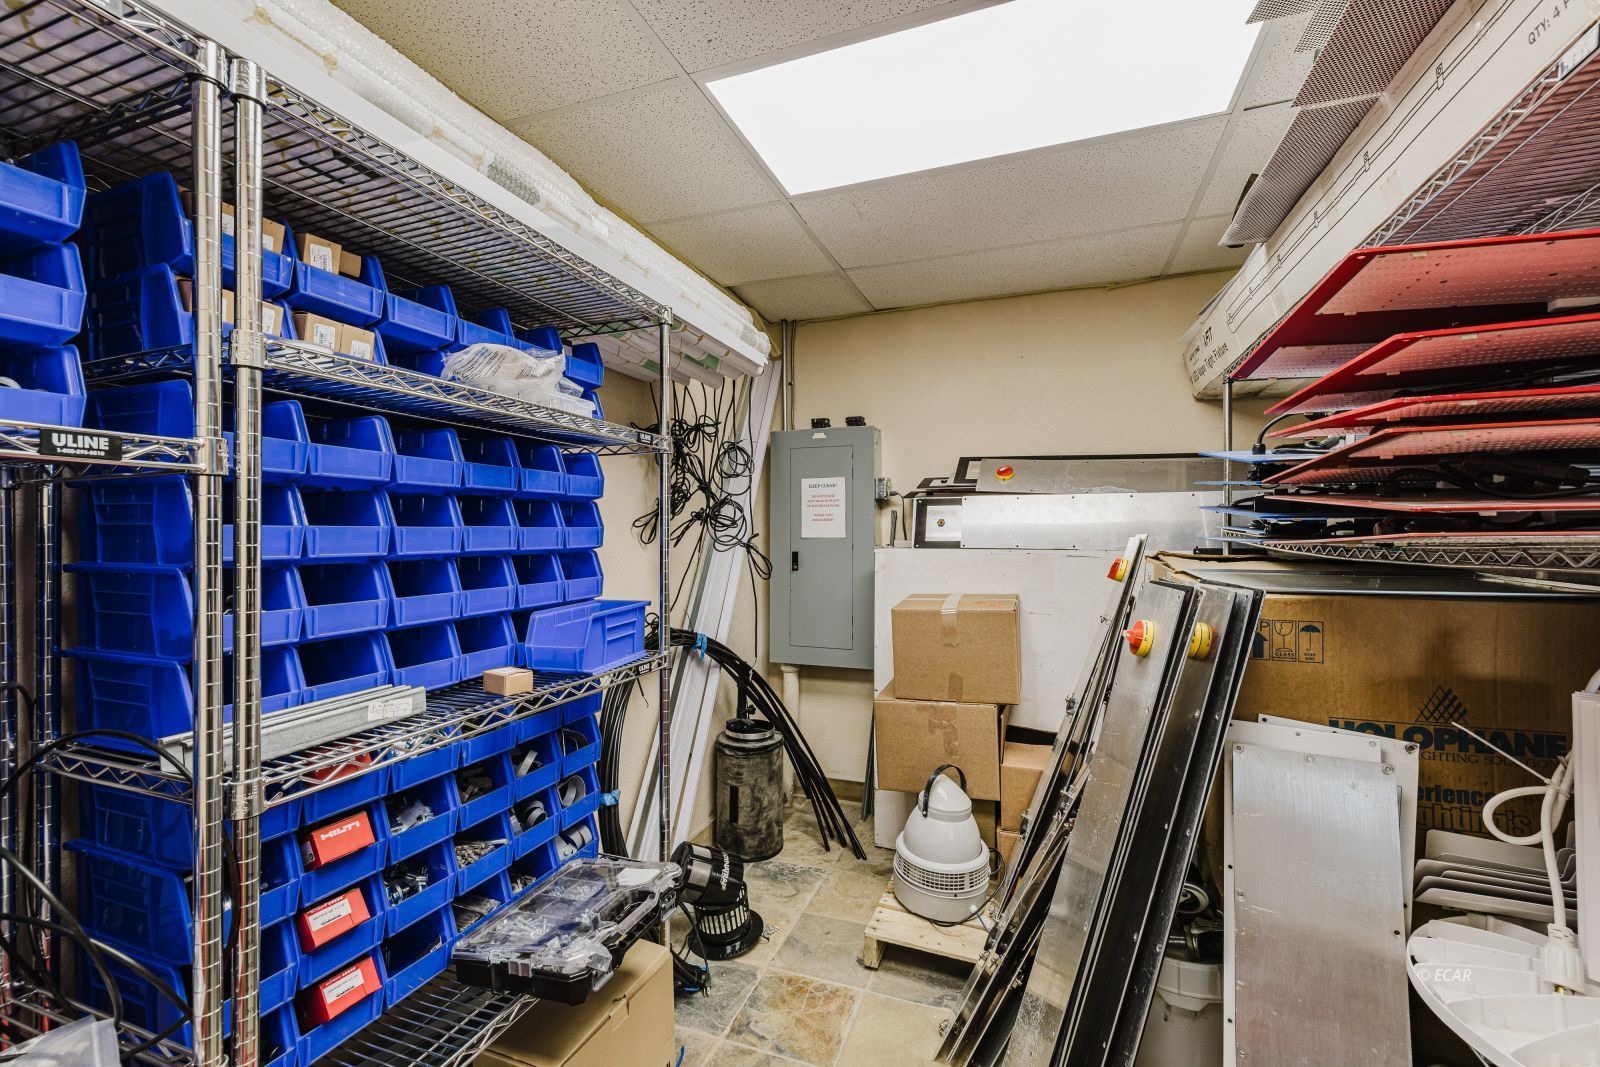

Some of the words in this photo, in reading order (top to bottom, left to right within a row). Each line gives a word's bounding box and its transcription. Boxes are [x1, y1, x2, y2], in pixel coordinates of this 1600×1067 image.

[1528, 18, 1550, 45] QTY:
[1553, 6, 1560, 18] 4
[1212, 342, 1229, 361] Fixture
[51, 432, 109, 450] ULINE
